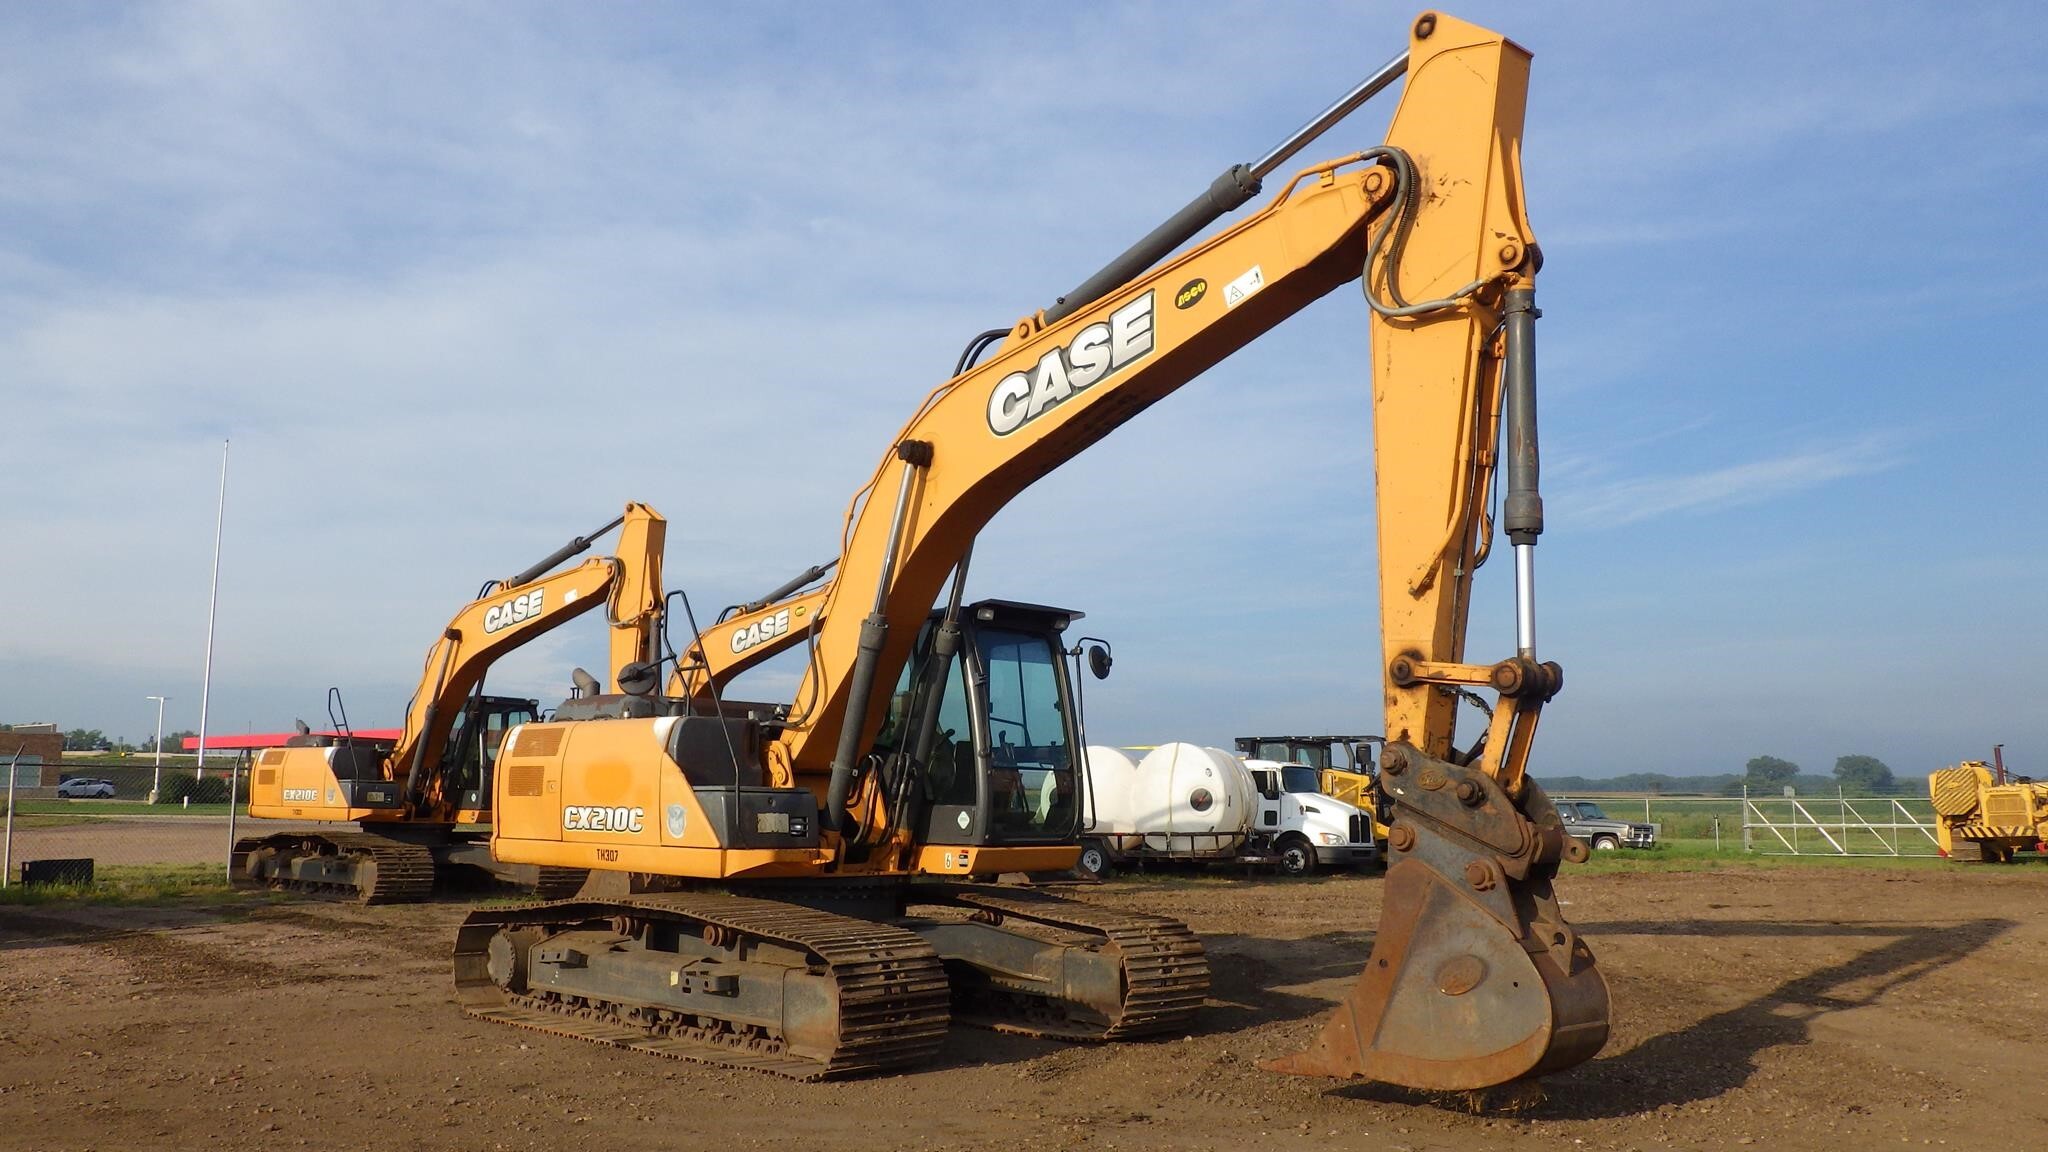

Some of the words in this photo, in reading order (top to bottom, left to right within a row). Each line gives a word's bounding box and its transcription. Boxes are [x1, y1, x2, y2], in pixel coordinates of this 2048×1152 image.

[1177, 281, 1206, 307] ASCO
[987, 288, 1155, 436] CASE
[484, 587, 544, 634] CASE
[731, 608, 790, 654] CASE
[564, 805, 644, 832] CX210C
[596, 848, 618, 862] TH307
